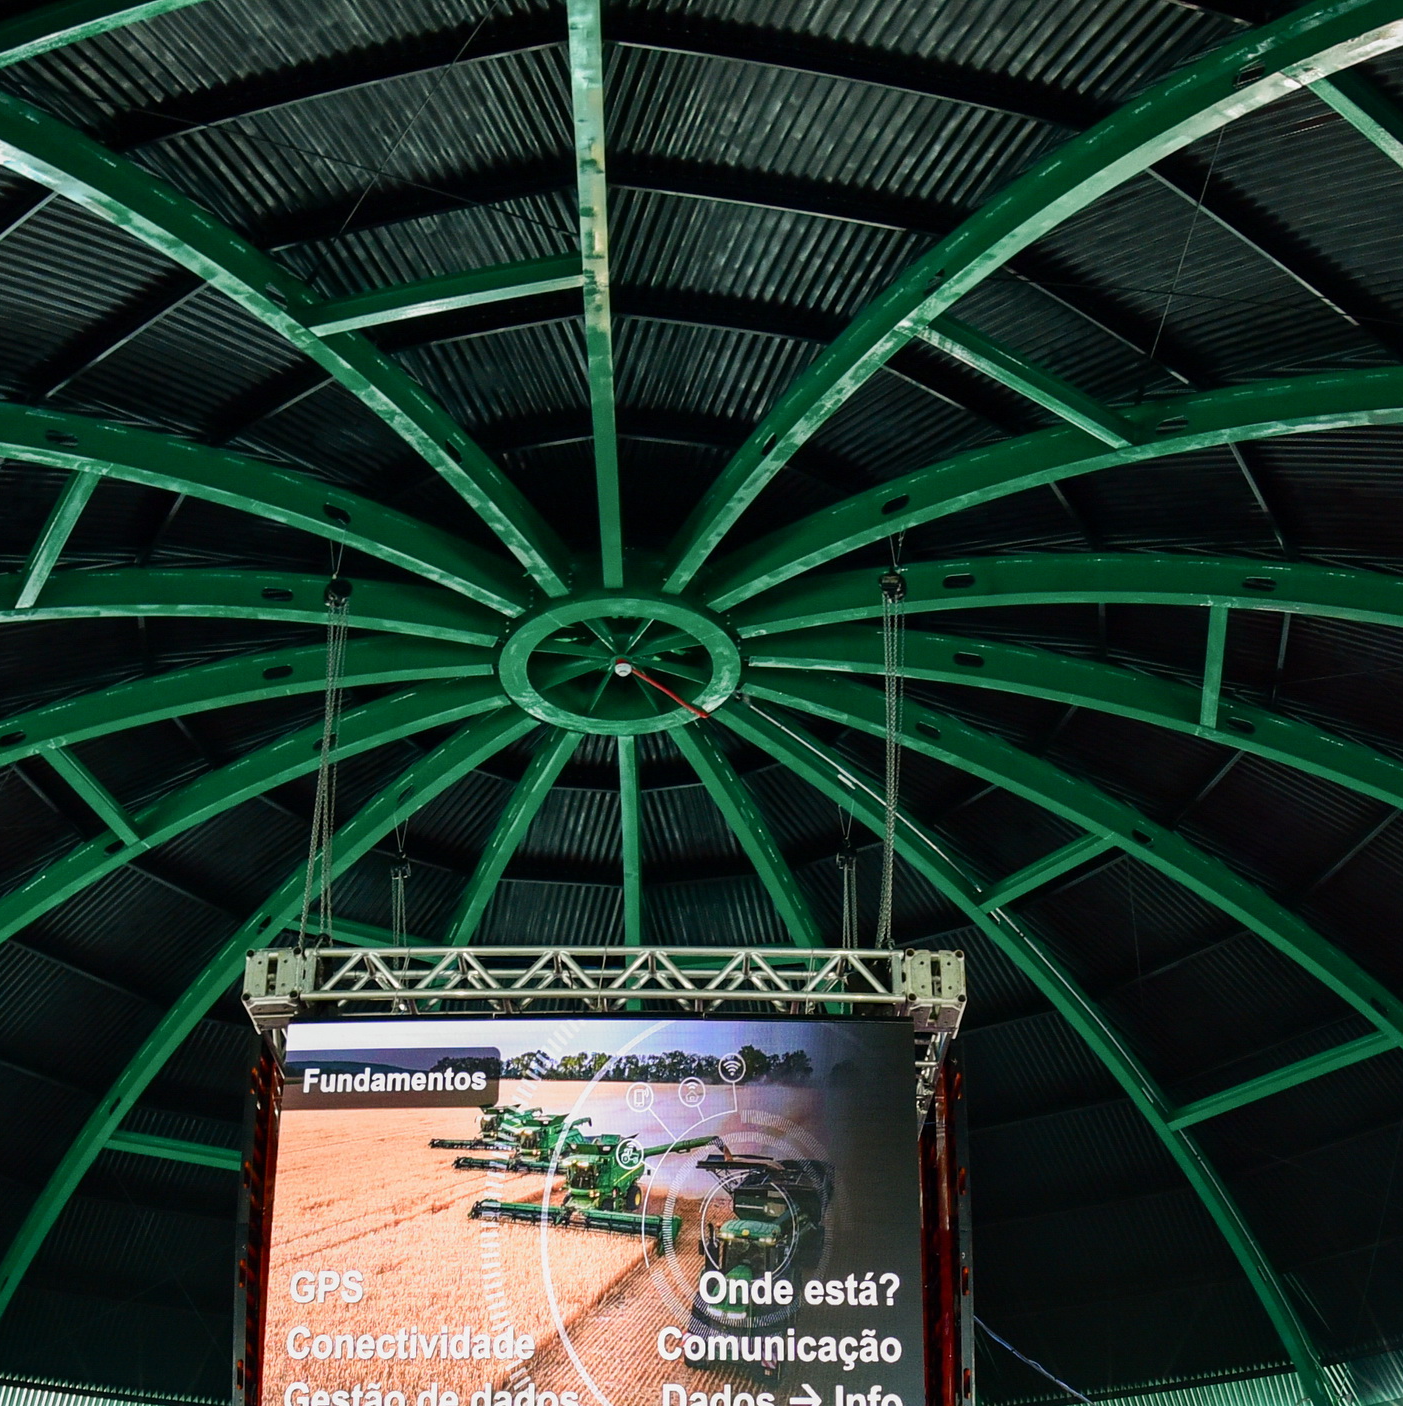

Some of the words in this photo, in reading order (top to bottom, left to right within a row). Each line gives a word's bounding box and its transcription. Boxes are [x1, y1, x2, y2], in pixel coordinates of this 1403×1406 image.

[302, 1066, 487, 1094] Fundamentos
[289, 1269, 364, 1304] GPS
[698, 1270, 795, 1307] Onde
[804, 1271, 900, 1307] está?
[286, 1325, 536, 1361] Conectividade
[657, 1326, 902, 1372] Comunicação
